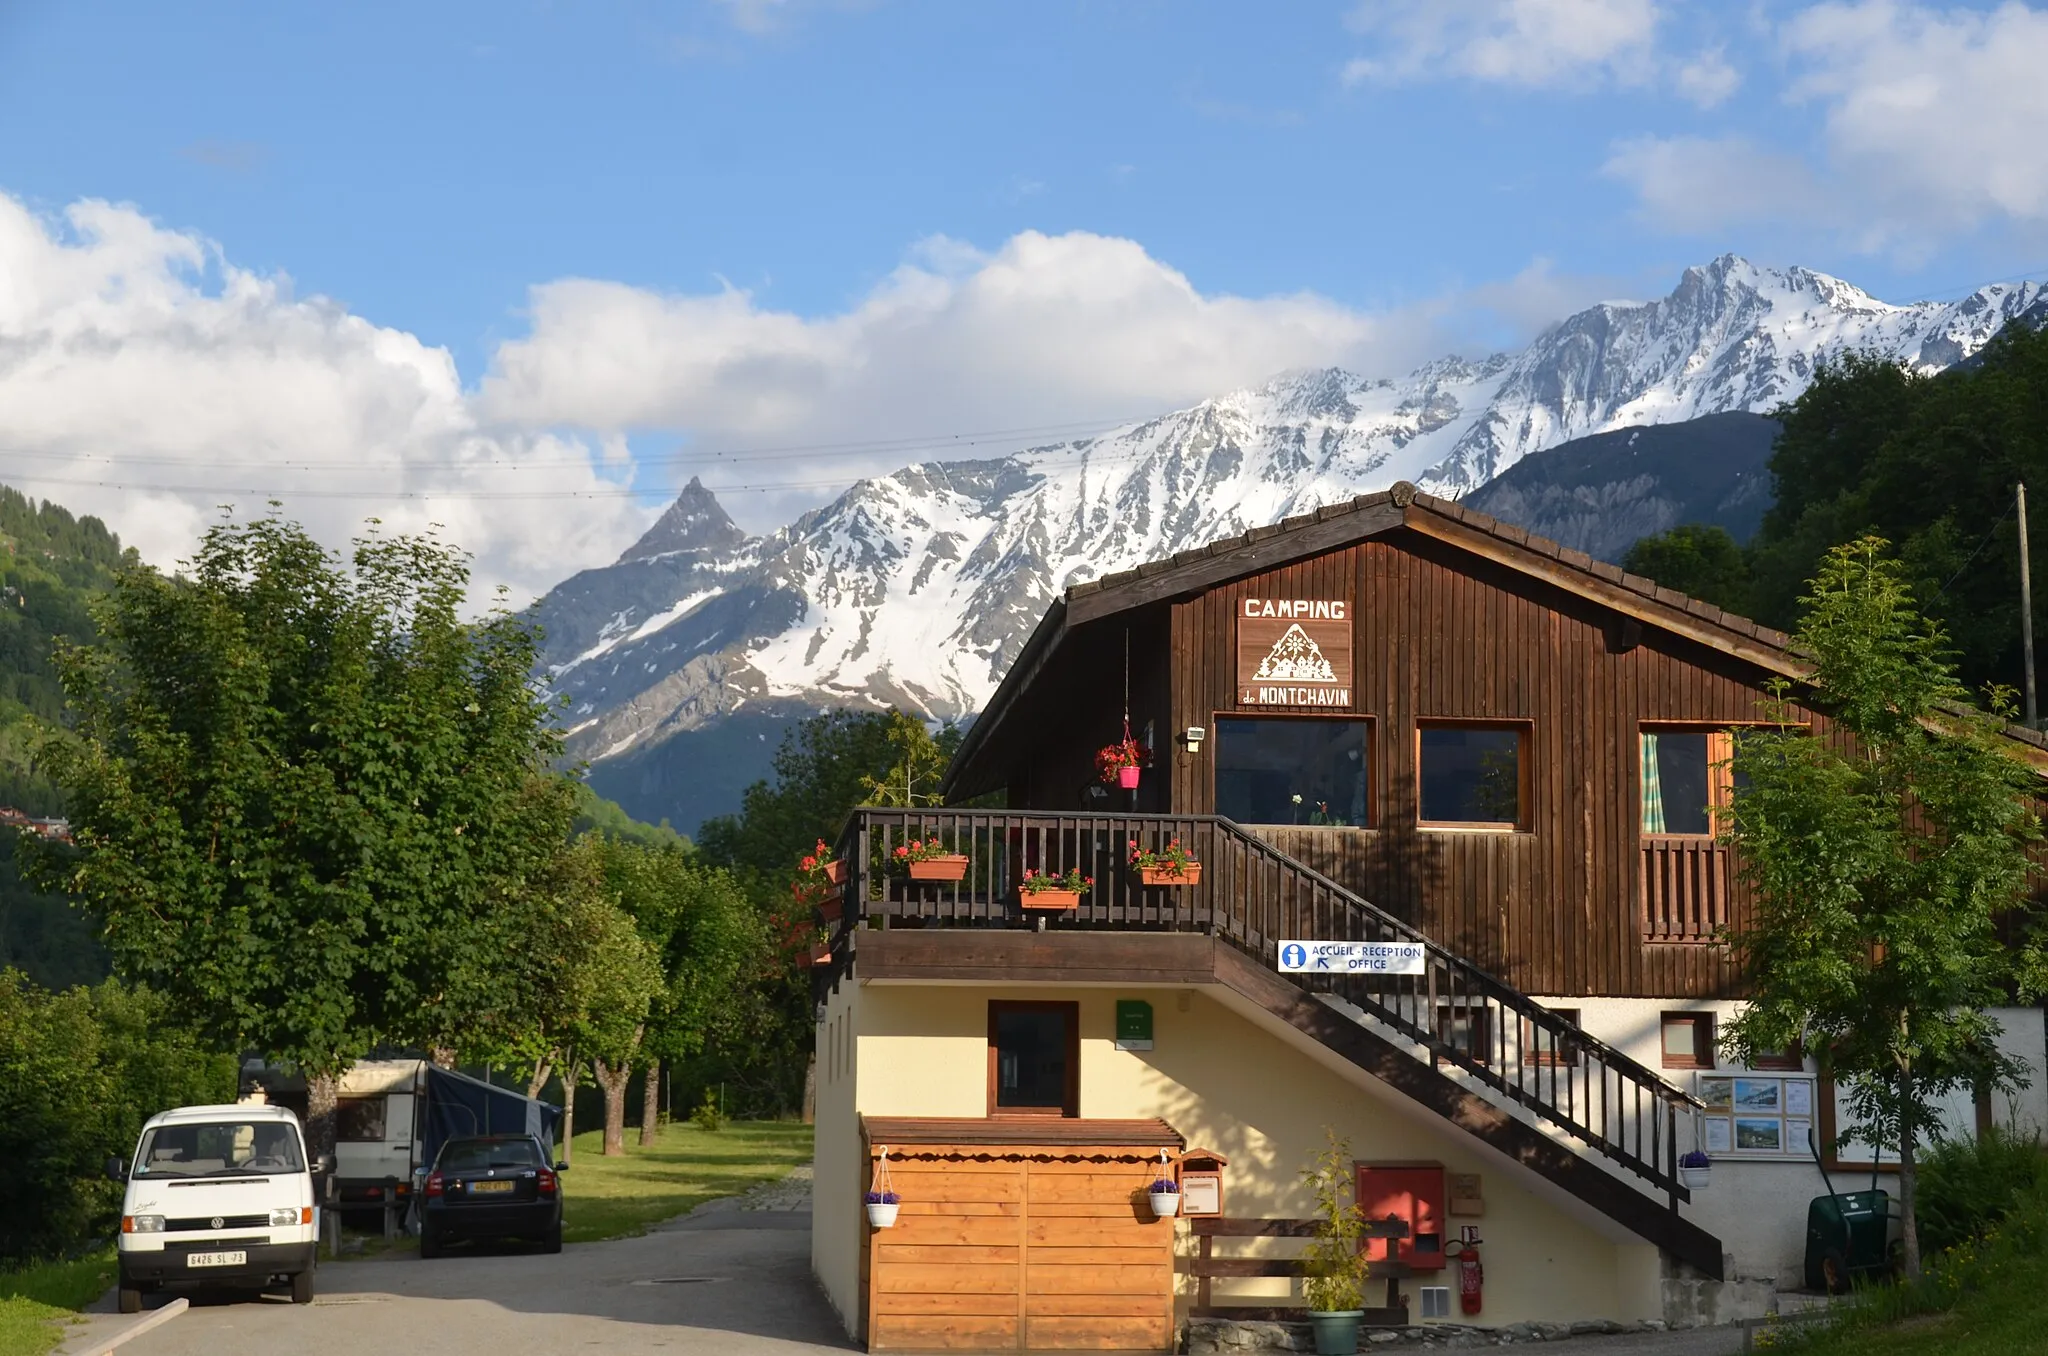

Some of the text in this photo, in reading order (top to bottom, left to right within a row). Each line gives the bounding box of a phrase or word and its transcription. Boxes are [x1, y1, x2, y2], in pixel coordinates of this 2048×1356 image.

[1245, 599, 1345, 619] CAMPING
[1243, 687, 1348, 705] de MONTCHAVIN
[1312, 945, 1354, 956] ACCUEIL
[1362, 946, 1421, 957] RECEPTION
[1348, 959, 1386, 969] OFFICE
[217, 1254, 226, 1264] SL
